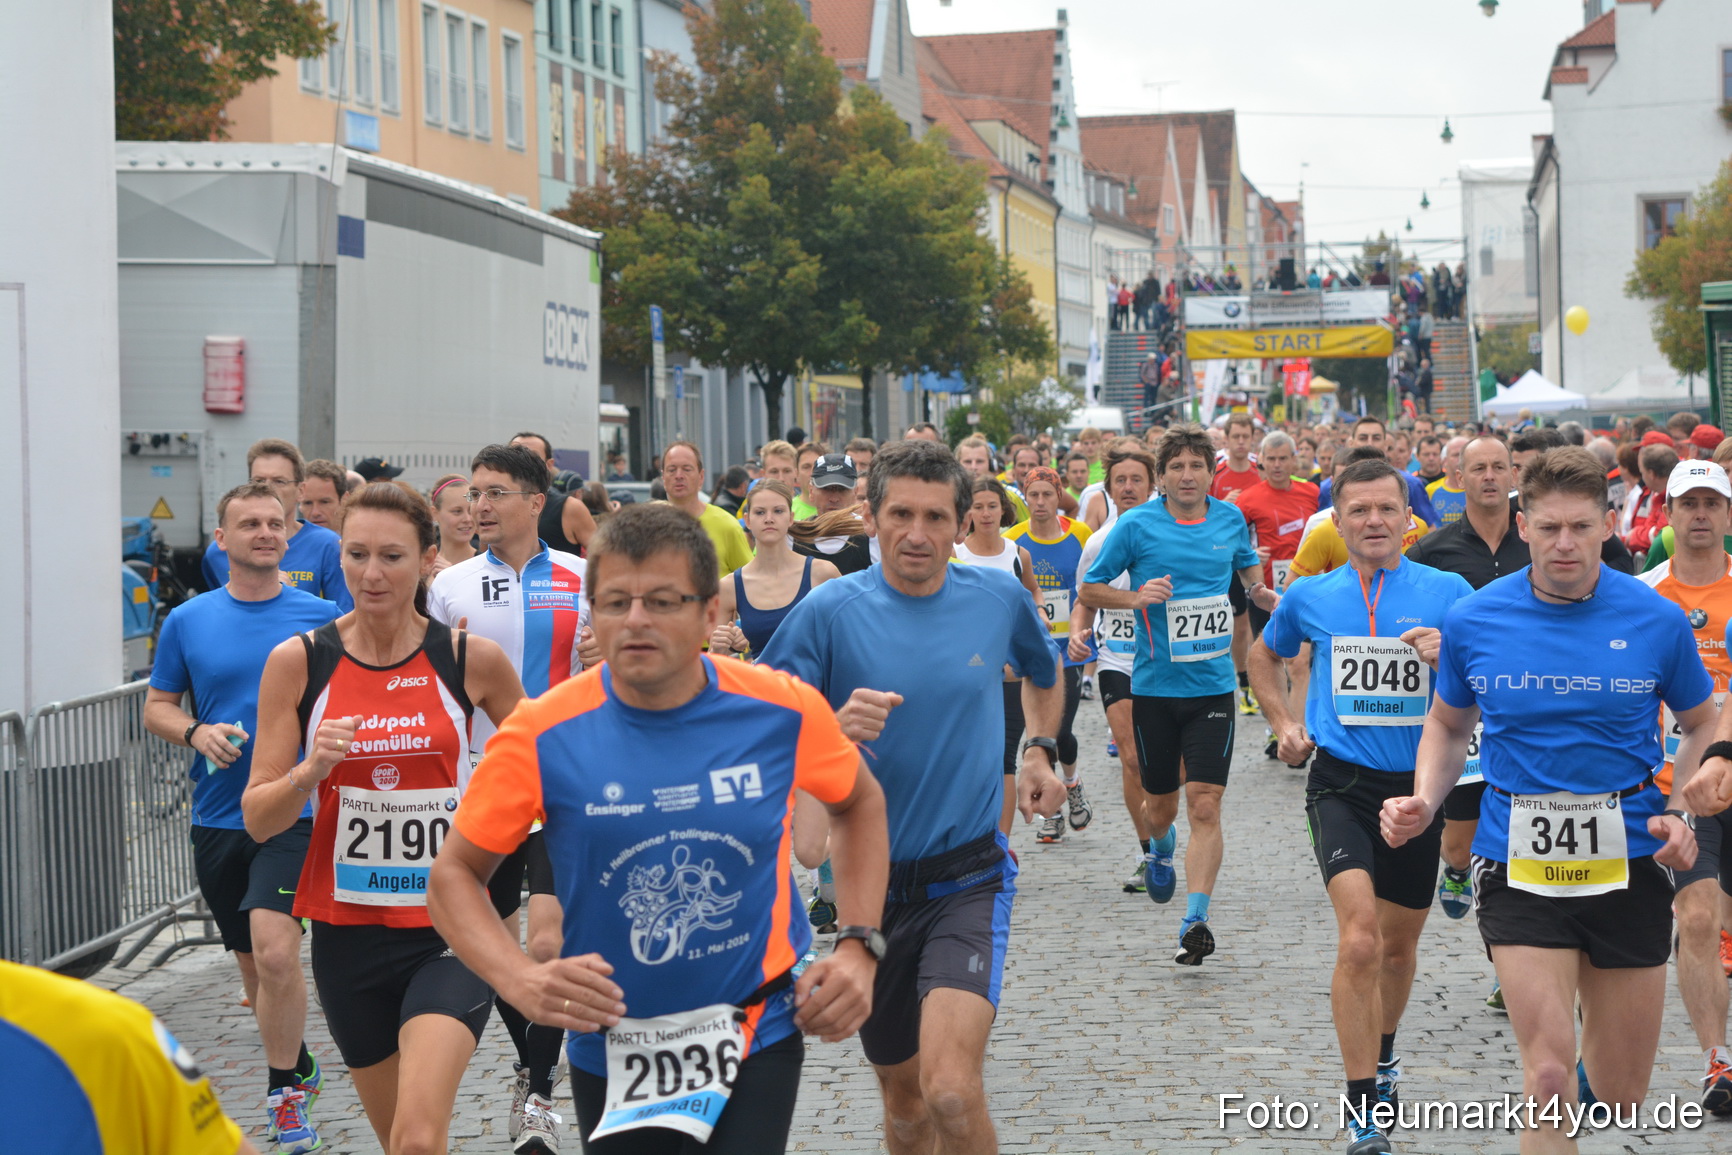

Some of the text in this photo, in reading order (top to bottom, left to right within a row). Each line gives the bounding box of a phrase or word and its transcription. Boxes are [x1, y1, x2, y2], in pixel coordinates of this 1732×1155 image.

[544, 301, 589, 371] BOCK
[1254, 334, 1324, 351] START
[1192, 602, 1222, 611] Neumarkt
[1175, 610, 1228, 638] 2742
[1192, 642, 1216, 652] Klaus
[1333, 645, 1413, 655] PARTL Neumarkt
[1340, 658, 1420, 692] 2048
[1495, 671, 1602, 695] ruhrgas
[1610, 678, 1656, 694] 1929
[1353, 699, 1404, 713] Michael
[348, 733, 431, 754] eumüller
[374, 768, 395, 777] SPORT
[379, 777, 398, 785] 2000
[342, 797, 440, 813] PARTL Neumarkt
[585, 803, 646, 816] Ensinger
[1513, 799, 1602, 811] PARTL Neumarkt
[347, 817, 450, 861] 2190
[1531, 816, 1598, 855] 341
[599, 871, 613, 887] 14.
[609, 834, 666, 871] Heilbronner
[368, 872, 426, 892] Angela
[1545, 866, 1590, 881] Oliver
[688, 932, 750, 960] 11. Mai 2014
[609, 1019, 728, 1046] PARTL Neumarkt
[623, 1039, 739, 1103] 2036
[633, 1097, 711, 1120] Michael
